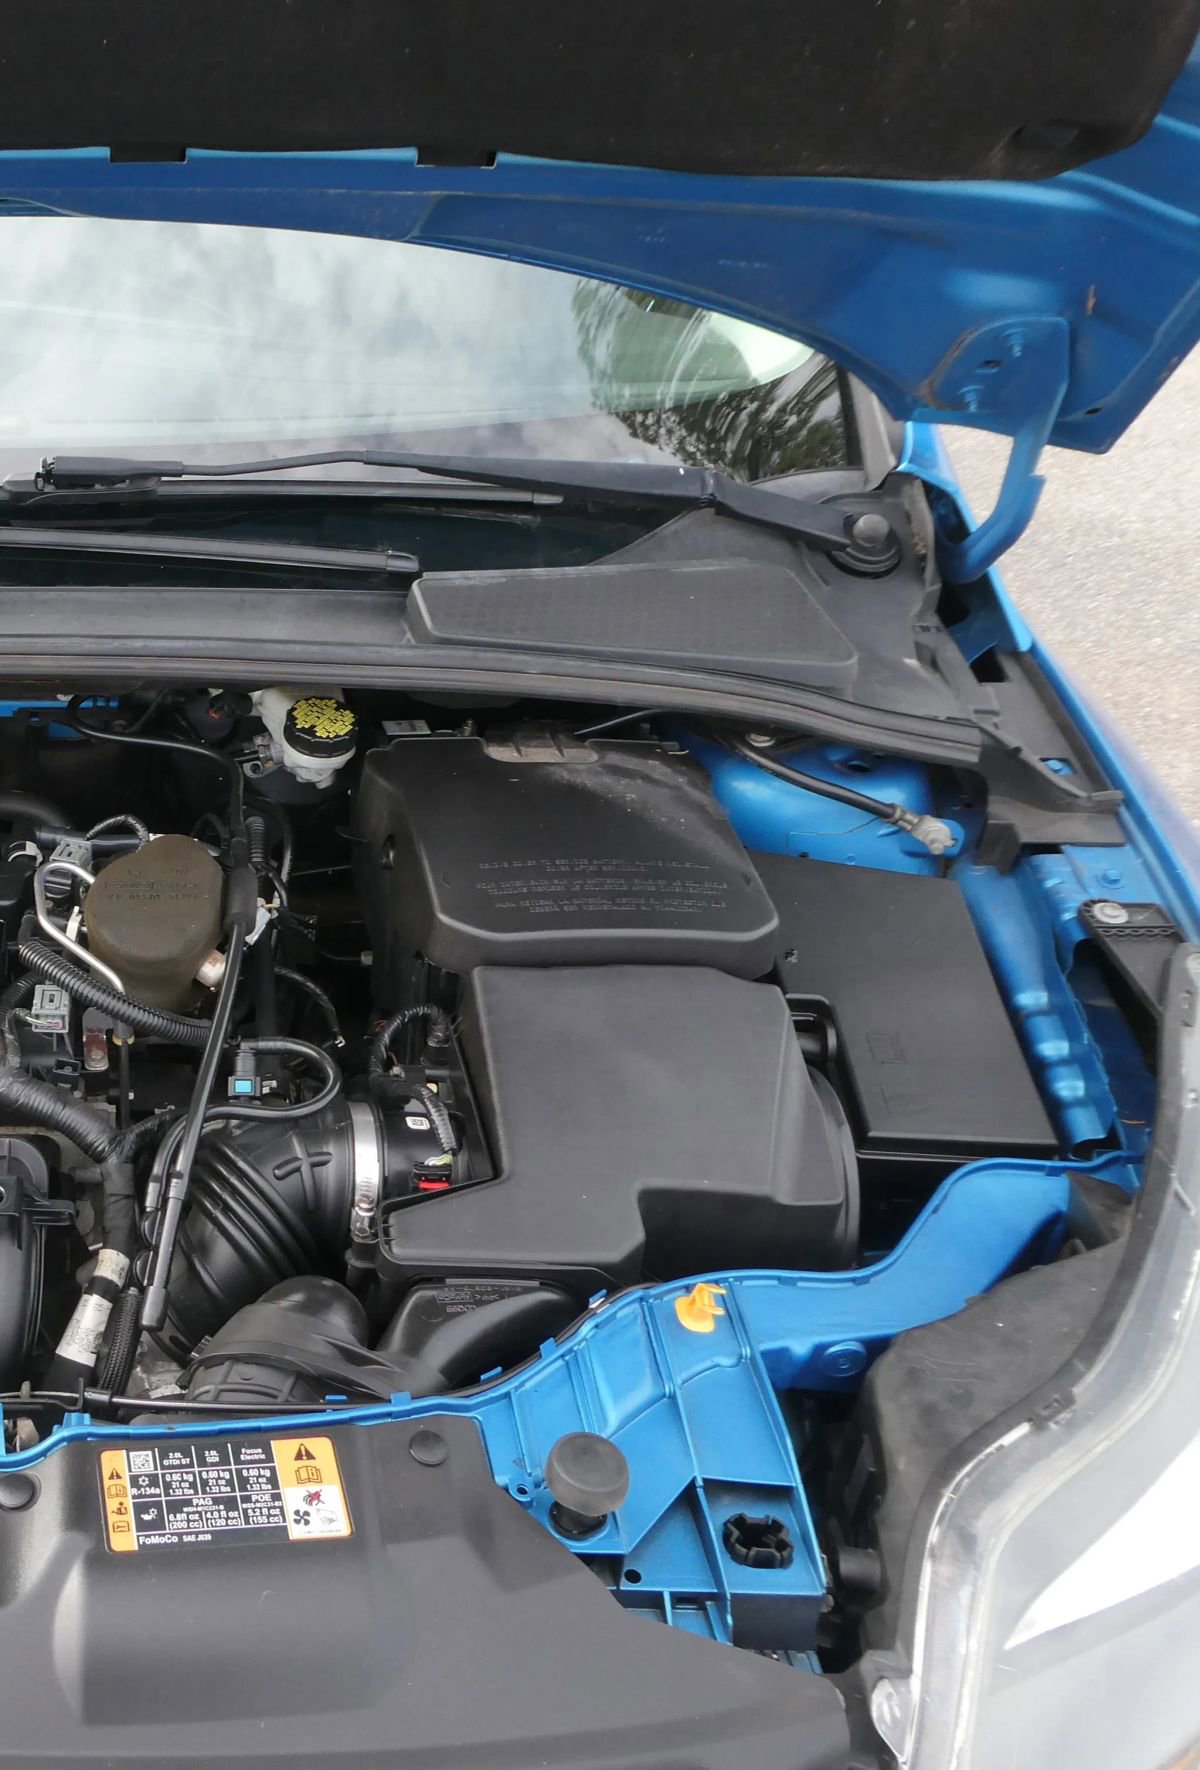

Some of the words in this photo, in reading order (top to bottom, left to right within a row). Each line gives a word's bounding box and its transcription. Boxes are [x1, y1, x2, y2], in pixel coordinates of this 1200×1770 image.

[182, 1472, 193, 1482] kg
[219, 1470, 230, 1479] kg
[259, 1468, 271, 1477] kg
[130, 1487, 160, 1496] R-134a
[192, 1497, 213, 1506] PAG
[251, 1494, 272, 1502] POE
[206, 1511, 219, 1519] 4.0
[220, 1510, 227, 1518] fl
[247, 1508, 260, 1516] 5.2
[208, 1518, 226, 1528] (120
[227, 1517, 240, 1526] cc)
[249, 1516, 268, 1525] (155
[269, 1514, 283, 1524] cc)
[169, 1521, 188, 1531] (200
[189, 1520, 203, 1529] cc)
[138, 1534, 178, 1544] FoMoCo
[182, 1534, 196, 1542] SAE
